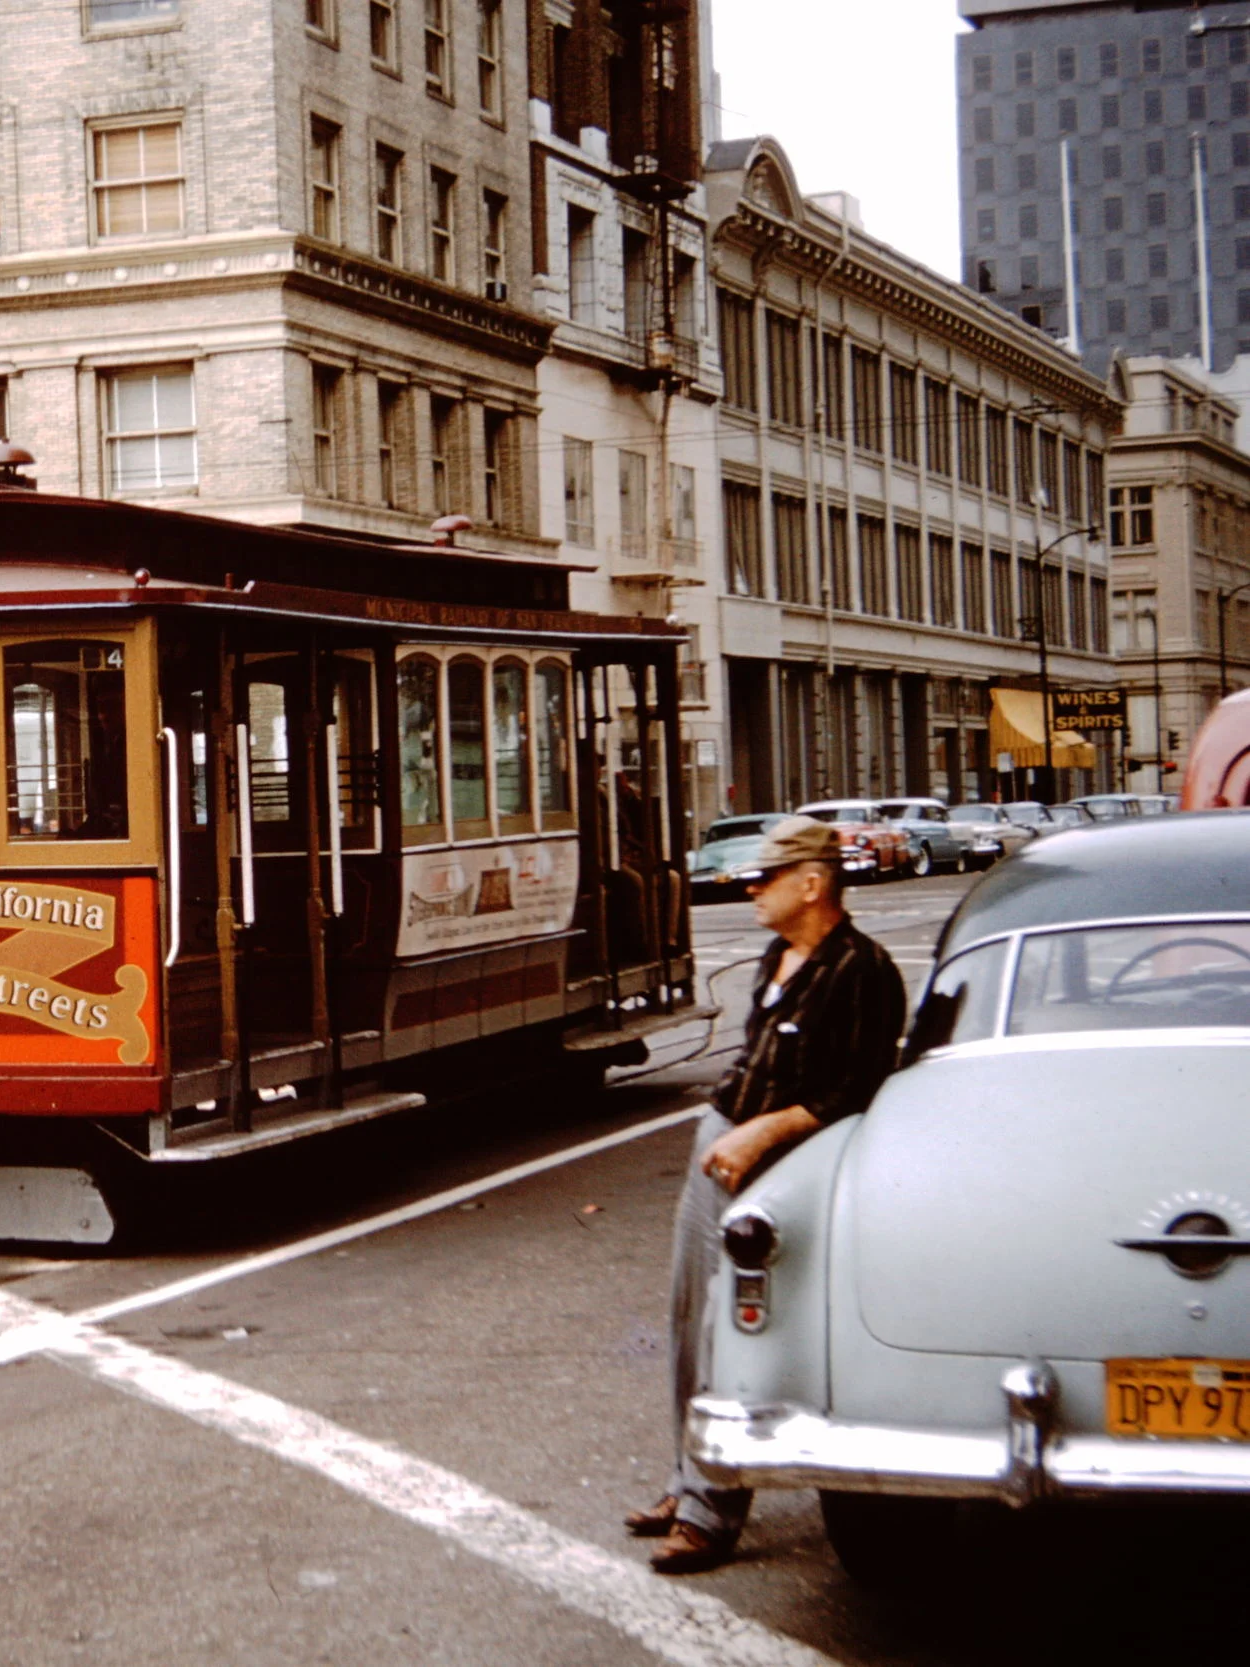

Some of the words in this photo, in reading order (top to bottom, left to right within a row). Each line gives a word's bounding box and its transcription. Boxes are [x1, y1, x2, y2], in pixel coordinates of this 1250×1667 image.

[1057, 691, 1120, 705] WINES
[1056, 714, 1124, 729] SPIRITS
[1116, 1383, 1191, 1426] DPY
